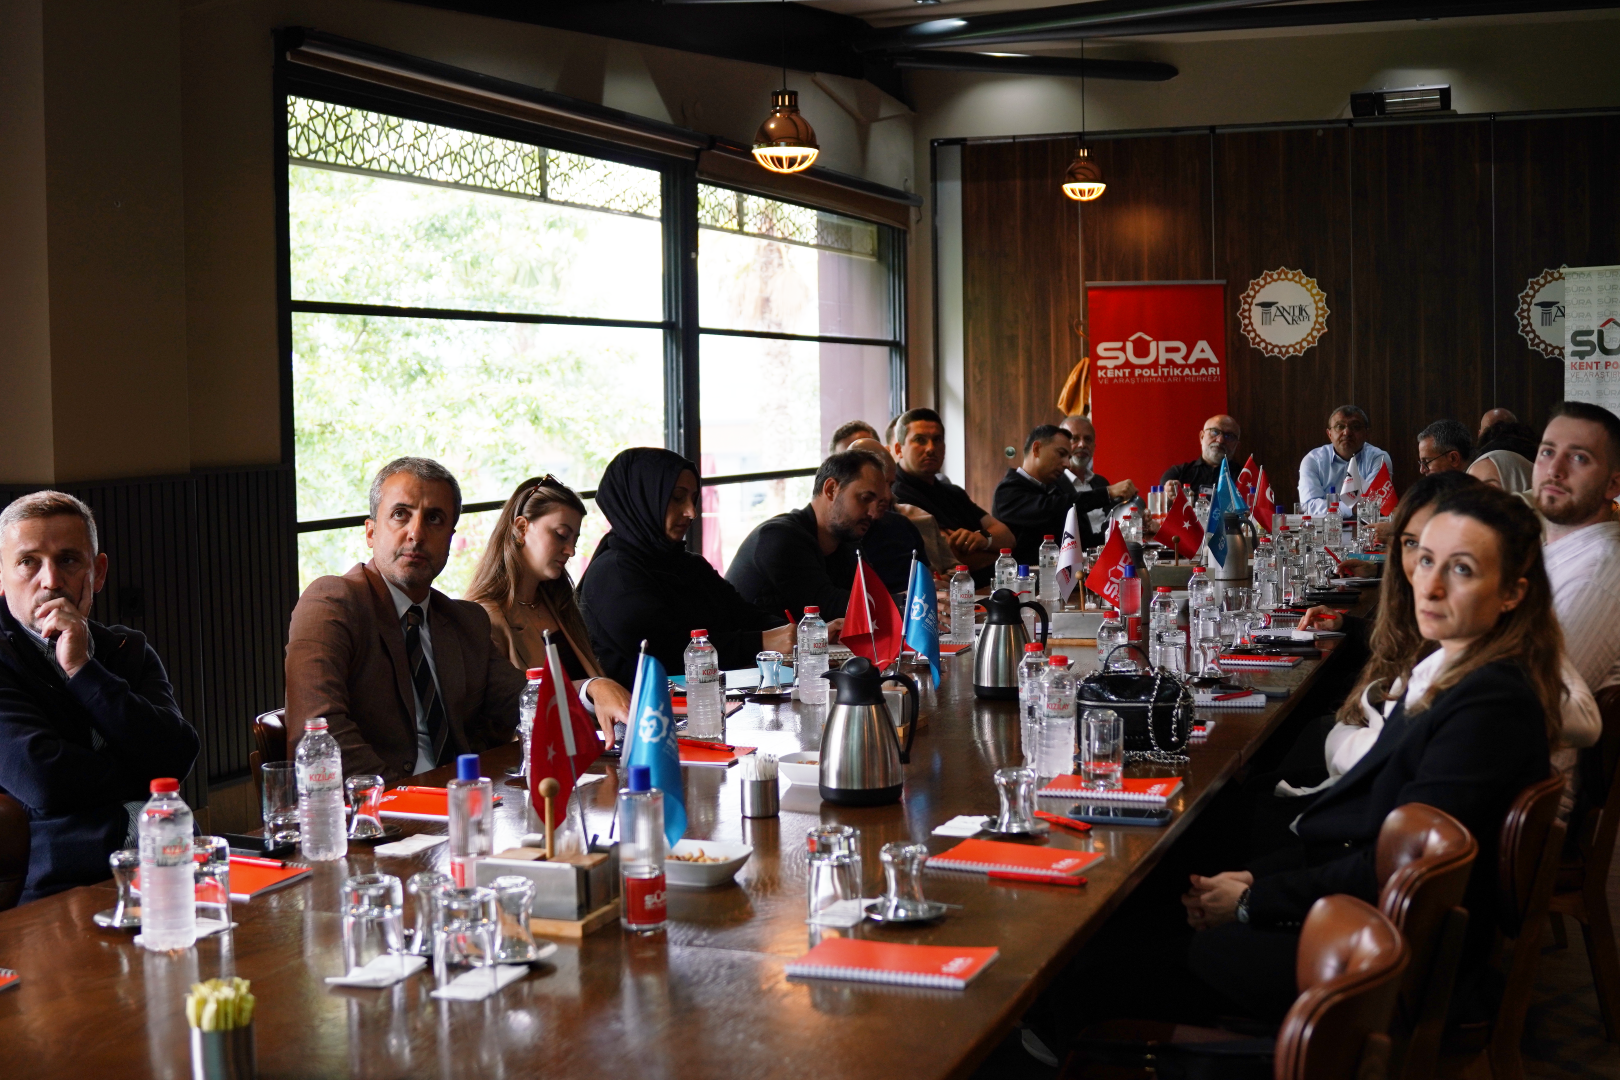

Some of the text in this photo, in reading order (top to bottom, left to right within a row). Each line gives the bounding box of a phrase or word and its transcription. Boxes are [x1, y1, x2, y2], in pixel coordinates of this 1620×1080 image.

[1096, 331, 1219, 369] ŞÛRA
[1570, 361, 1601, 370] KENT
[1097, 365, 1220, 378] KENT POLİTİKALARI
[1113, 376, 1181, 385] ARAŞTIRMALARI
[1046, 702, 1070, 711] KIZILAY
[309, 771, 336, 782] KIZILAY
